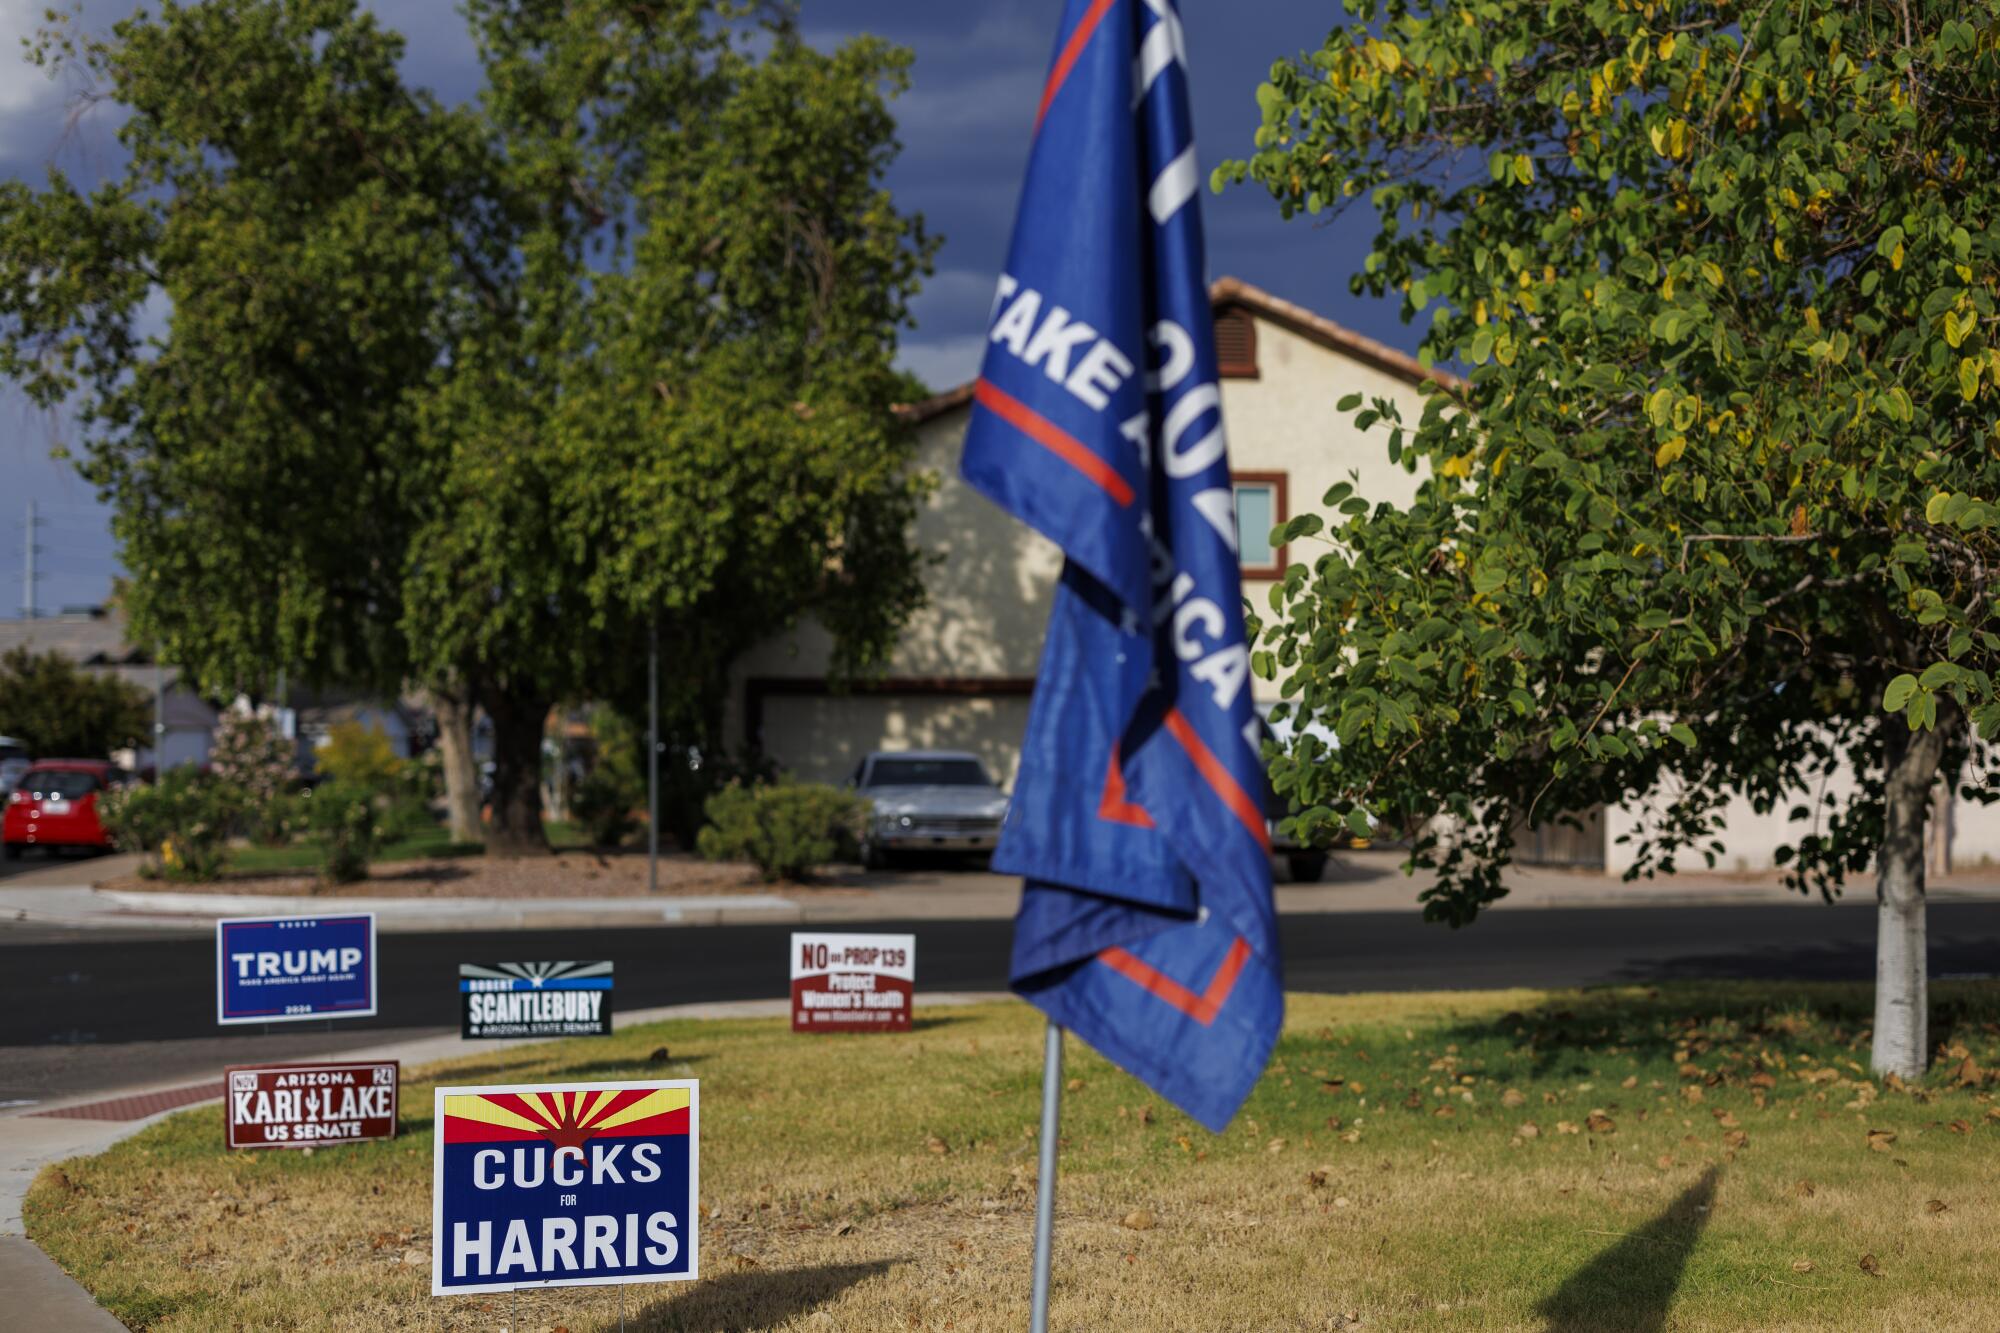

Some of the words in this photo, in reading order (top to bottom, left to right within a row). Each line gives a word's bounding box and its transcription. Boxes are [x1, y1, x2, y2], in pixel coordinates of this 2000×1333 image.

[231, 947, 362, 978] TRUMP
[801, 943, 829, 970] NO
[844, 947, 879, 965] PROP
[881, 949, 907, 967] 139
[469, 991, 602, 1024] SCANTLEBURY
[480, 1024, 530, 1035] ARIZONA
[531, 1022, 561, 1034] STATE
[563, 1021, 603, 1033] SENATE
[275, 1072, 355, 1087] ARIZONA
[233, 1088, 303, 1125] KARI
[321, 1085, 393, 1121] LAKE
[264, 1124, 289, 1141] US
[293, 1121, 362, 1140] SENATE
[473, 1143, 662, 1190] CUCKS
[560, 1194, 577, 1206] FOR
[453, 1211, 679, 1277] HARRIS
